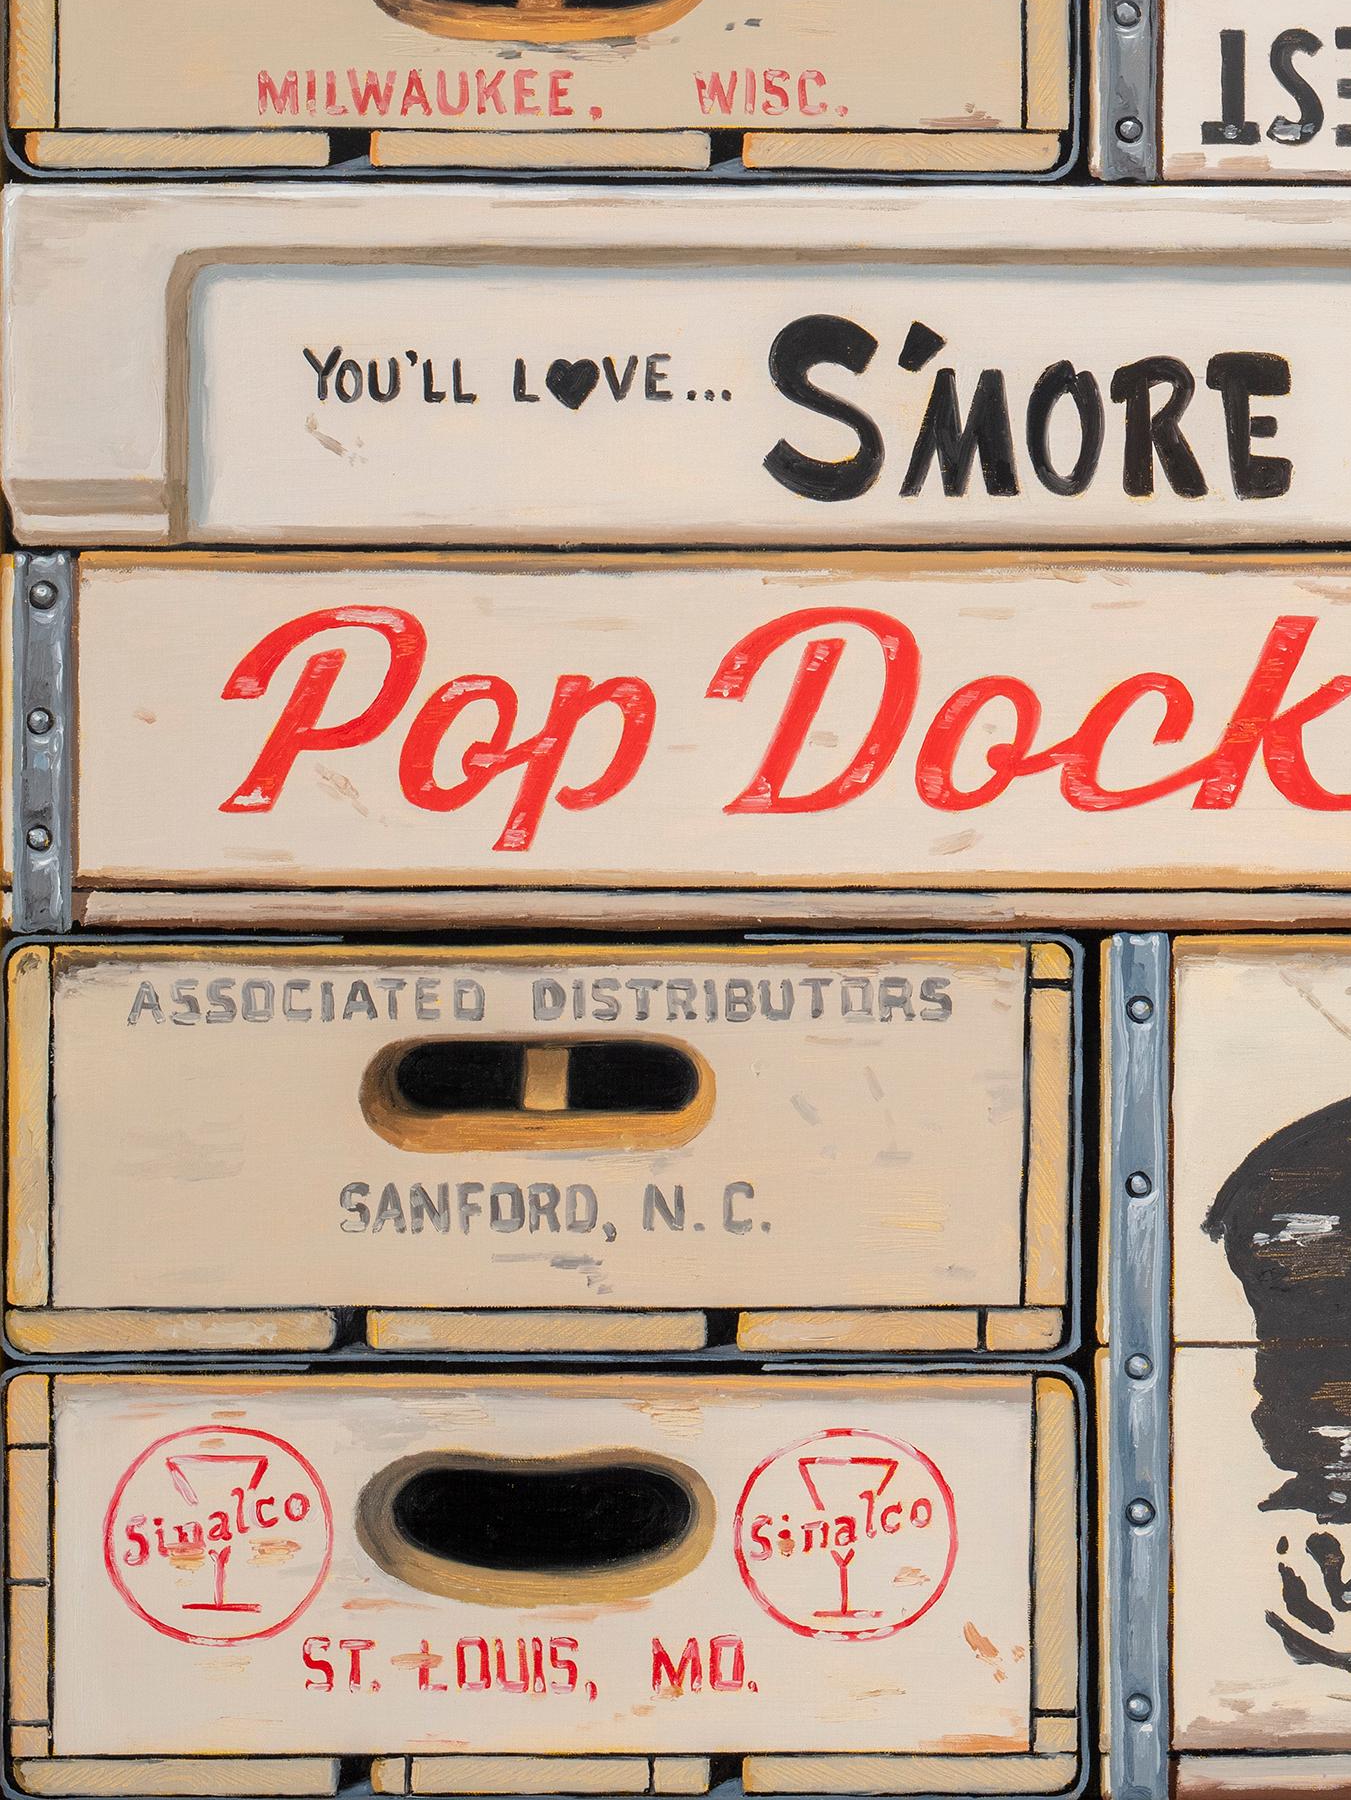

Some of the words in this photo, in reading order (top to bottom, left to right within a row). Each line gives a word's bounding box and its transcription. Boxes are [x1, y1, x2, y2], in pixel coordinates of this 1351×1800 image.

[692, 68, 849, 117] WISC.
[302, 344, 478, 404] YOU'LL
[761, 313, 1295, 503] S'MORE
[218, 604, 658, 853] Pop
[127, 977, 487, 1027] ASSOCIATED
[532, 975, 954, 1025] DISTRIBUTORS
[337, 1180, 619, 1243] SANFORD,
[123, 1487, 311, 1567] Sinalco
[750, 1490, 933, 1562] Sinalco
[302, 1636, 381, 1695] ST.
[650, 1634, 760, 1698] MO.
